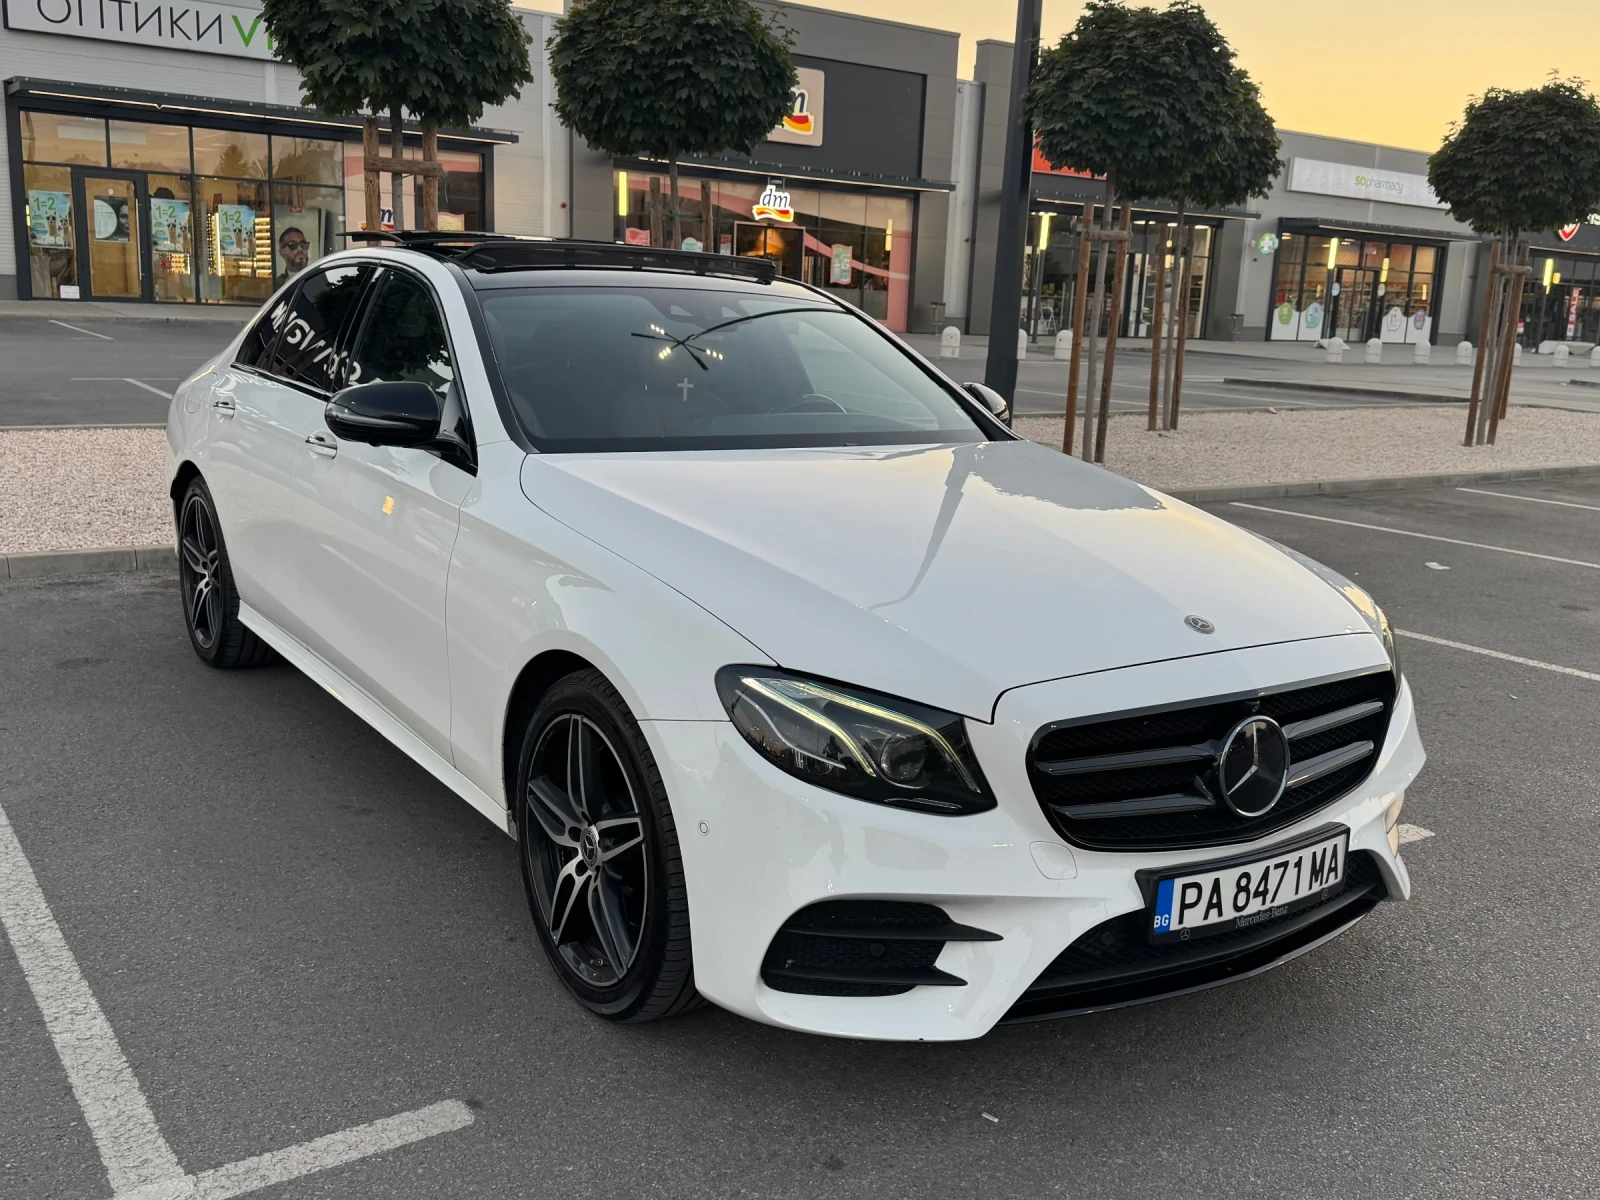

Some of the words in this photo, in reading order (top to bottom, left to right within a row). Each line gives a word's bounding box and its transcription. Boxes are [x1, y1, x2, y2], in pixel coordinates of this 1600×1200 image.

[33, 196, 57, 211] 1=2
[762, 188, 788, 209] dm
[155, 205, 177, 219] 1=2
[222, 210, 242, 224] 1=2
[1177, 878, 1223, 926] PA
[1232, 855, 1303, 913] 8471
[1308, 843, 1340, 892] MA
[1154, 915, 1170, 928] BG
[1235, 905, 1289, 929] Mercedes-Benz
